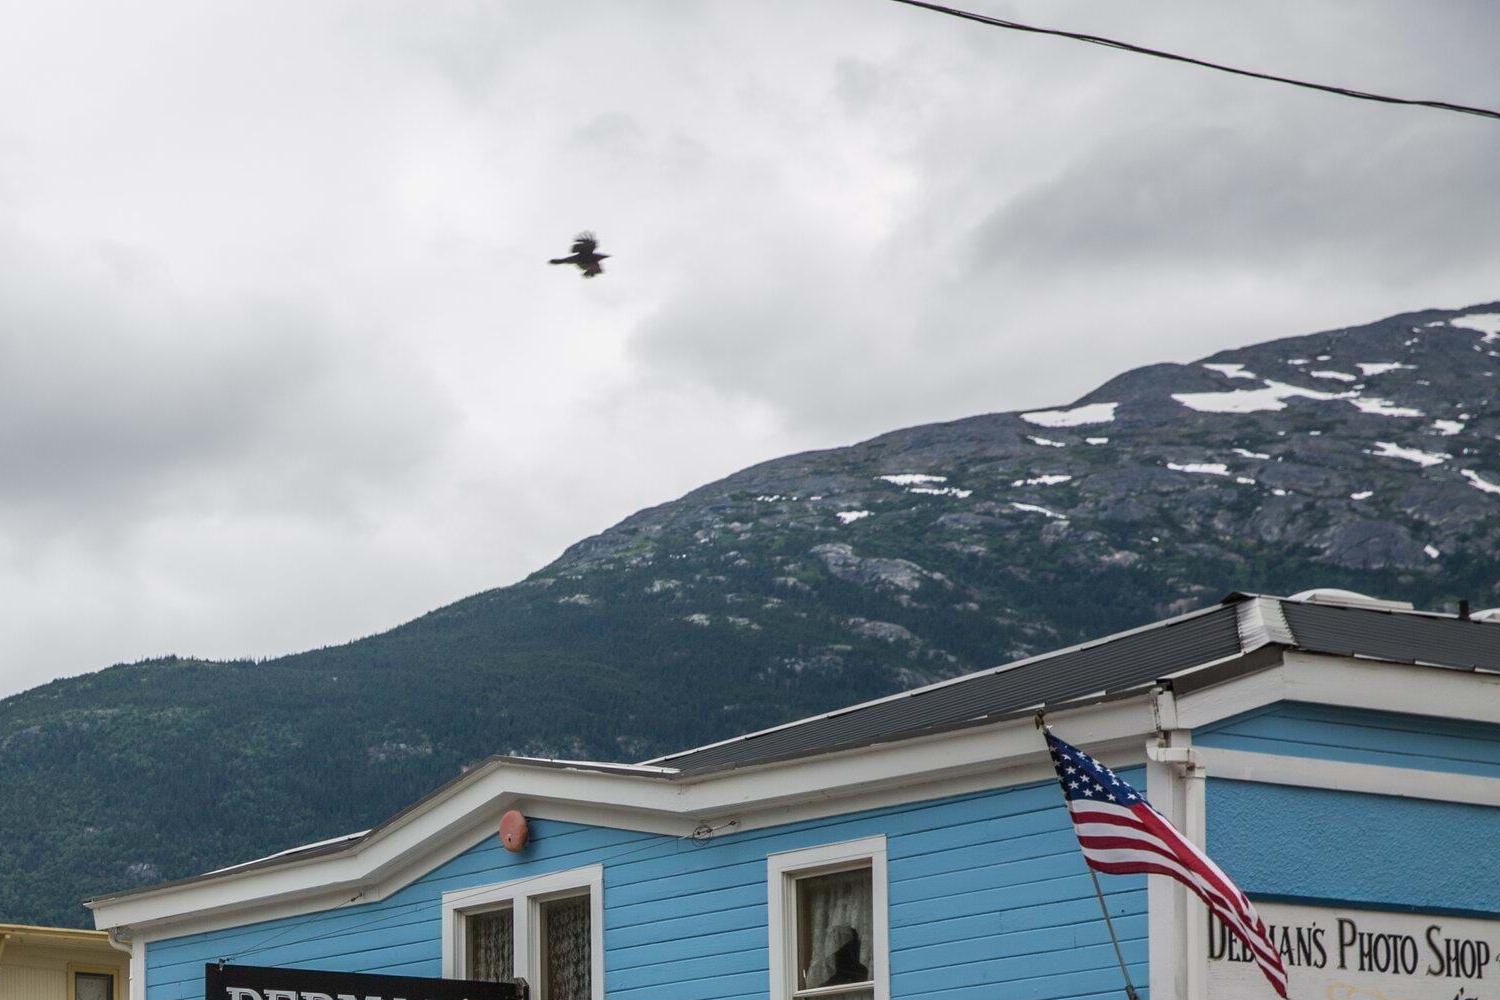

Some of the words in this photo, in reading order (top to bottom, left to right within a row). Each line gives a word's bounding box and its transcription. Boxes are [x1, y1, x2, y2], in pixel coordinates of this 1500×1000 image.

[1207, 907, 1328, 969] DEAN'S
[1336, 917, 1418, 975] PHOTO
[1425, 925, 1490, 979] SHOP
